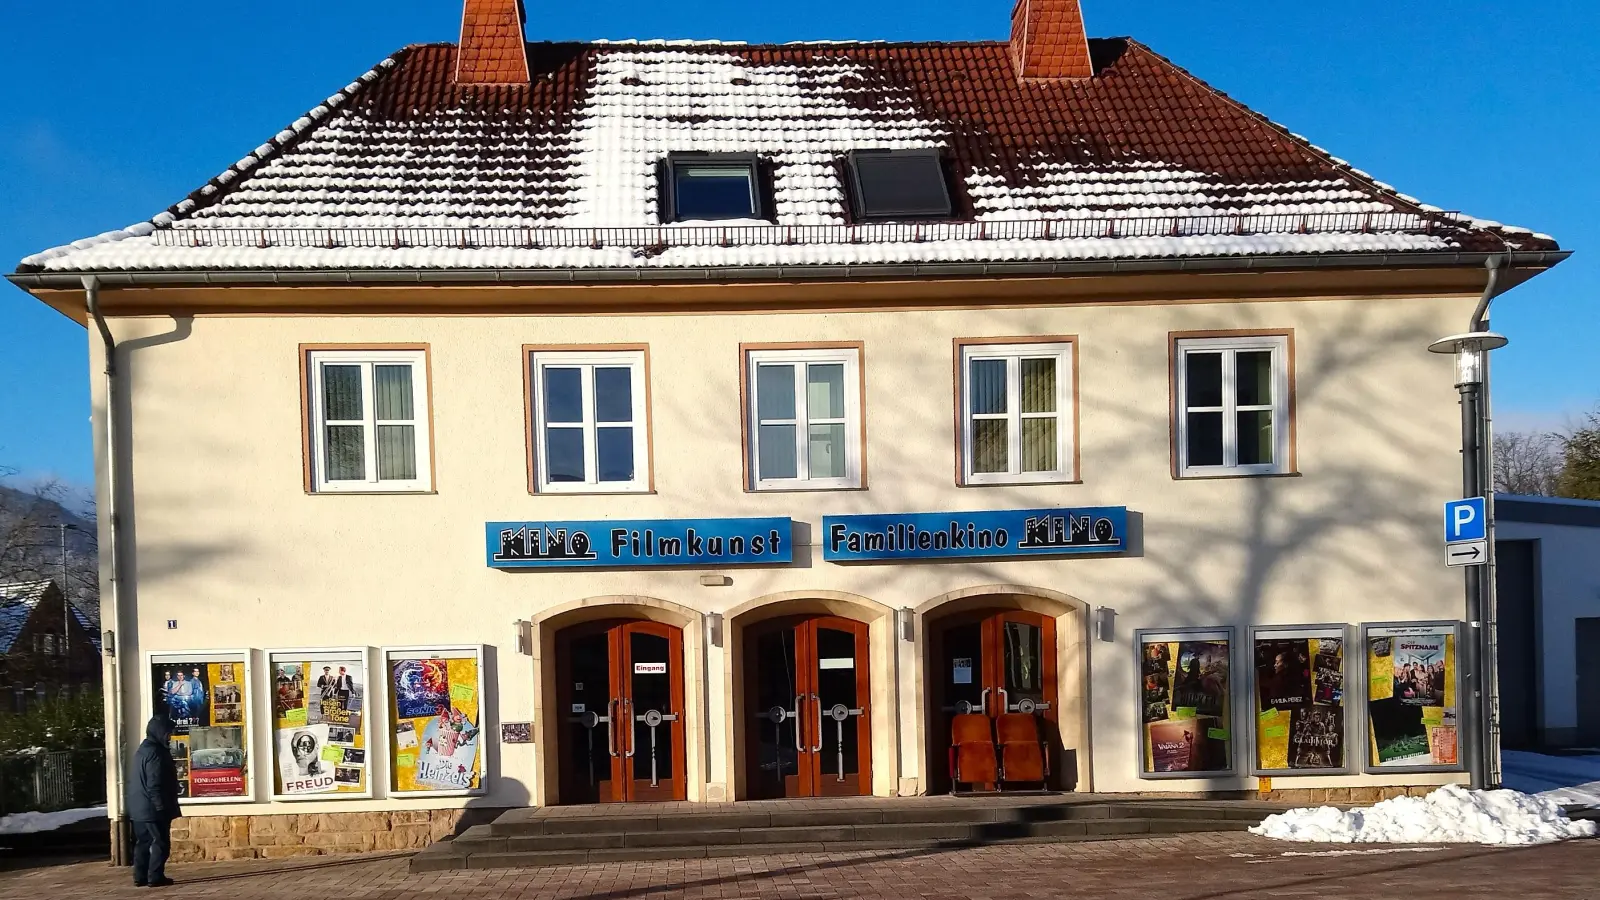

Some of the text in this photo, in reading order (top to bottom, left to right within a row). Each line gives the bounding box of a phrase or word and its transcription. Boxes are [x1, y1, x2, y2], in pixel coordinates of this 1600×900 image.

[1454, 505, 1475, 536] P
[830, 513, 1120, 553] Familienkino KINO
[493, 525, 780, 561] KINO Filmkunst
[323, 707, 351, 716] großen
[330, 714, 350, 722] Töne
[405, 705, 436, 716] SONIC
[176, 717, 189, 725] drei
[419, 761, 471, 788] Heinzels
[286, 777, 334, 792] FREUD
